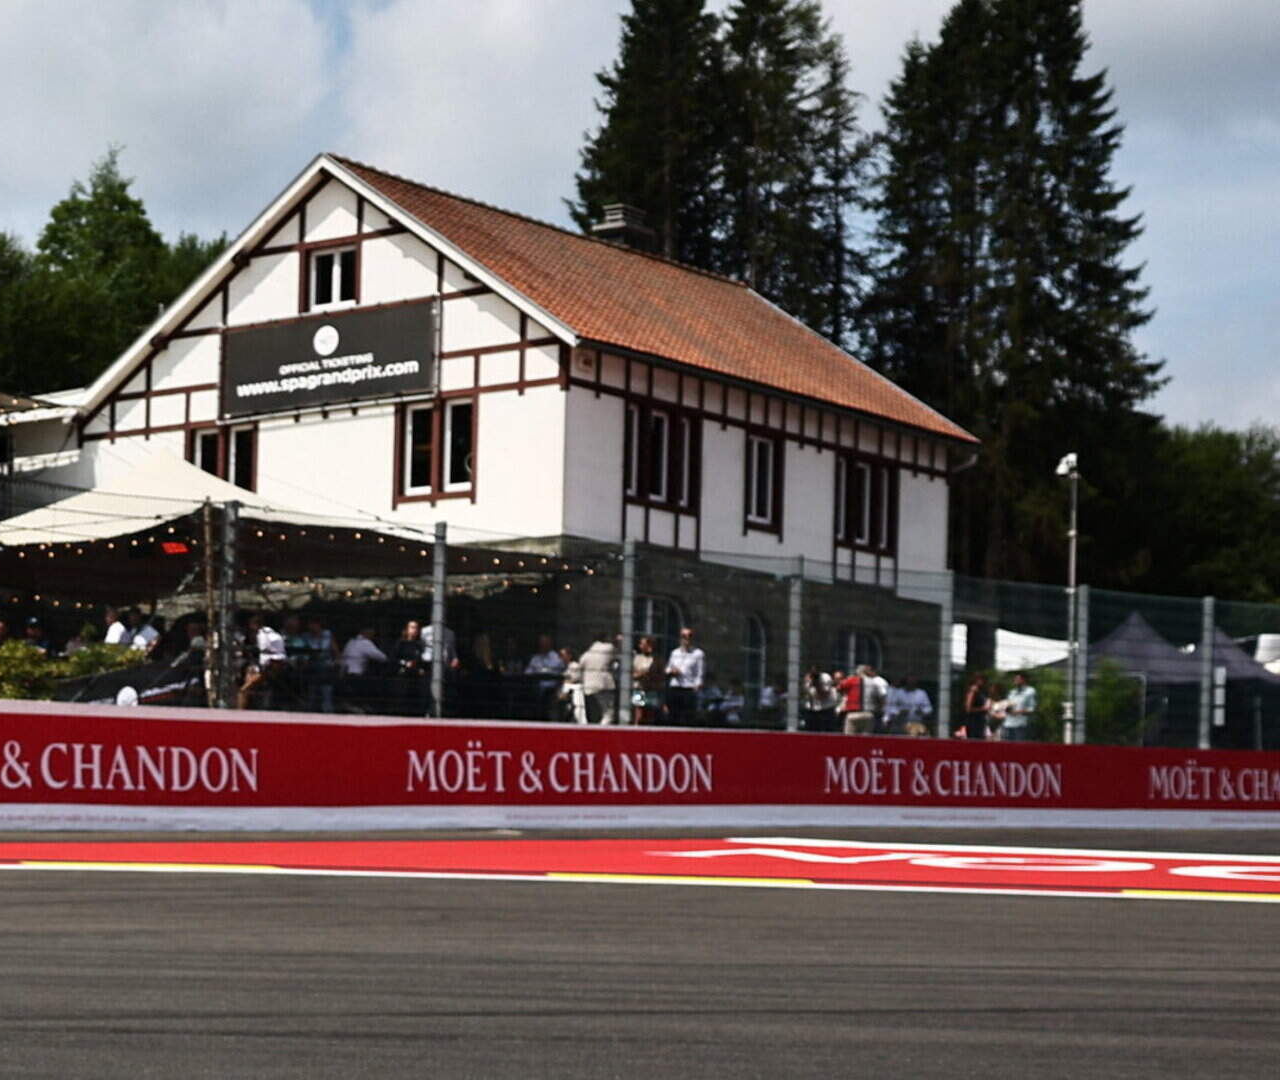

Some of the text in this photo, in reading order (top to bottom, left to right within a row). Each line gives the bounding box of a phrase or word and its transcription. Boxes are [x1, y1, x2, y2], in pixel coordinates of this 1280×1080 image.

[235, 360, 419, 397] www.spagrandprix.com
[278, 353, 374, 375] OFFICIAL TICKETING
[0, 741, 32, 788] &
[40, 742, 259, 793] CHANDON
[407, 740, 713, 794] MOËT & CHANDON
[825, 749, 1062, 798] MOËT & CHANDON
[1149, 758, 1214, 800] MOËT
[1219, 770, 1235, 801] &
